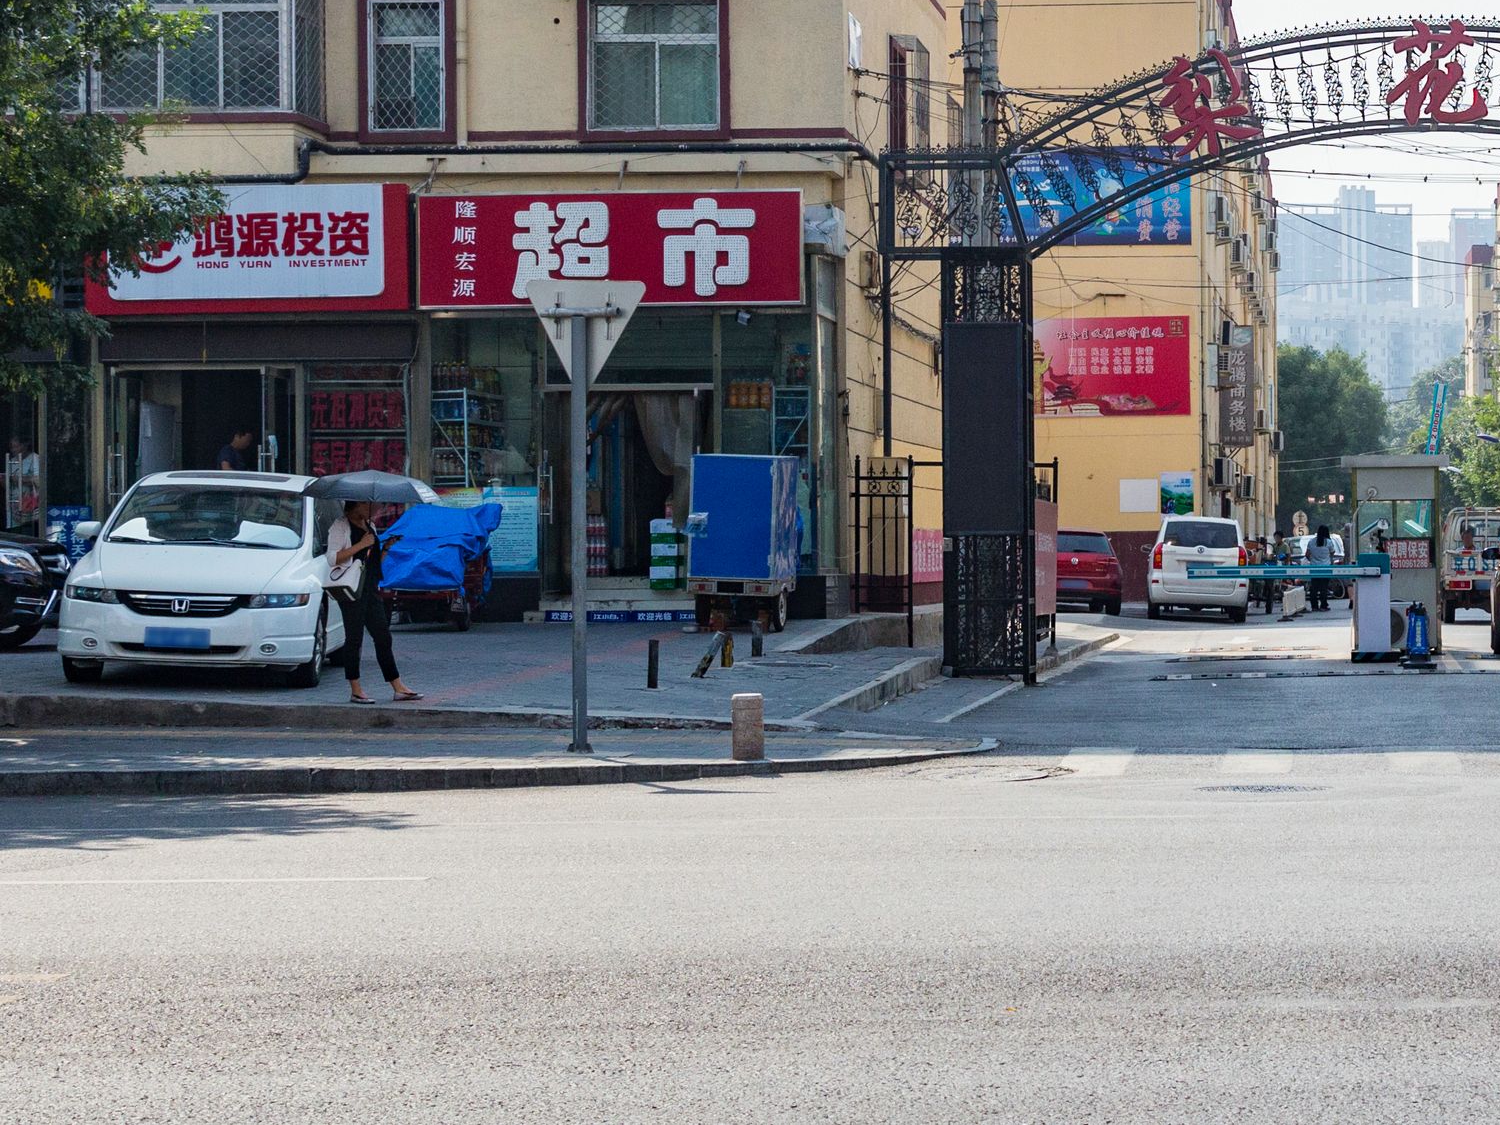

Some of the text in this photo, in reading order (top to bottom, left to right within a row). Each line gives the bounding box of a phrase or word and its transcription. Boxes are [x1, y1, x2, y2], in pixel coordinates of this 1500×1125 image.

[192, 211, 370, 257] 鸿源投资
[197, 258, 368, 269] HONG YUAN INVESTMENT
[452, 201, 477, 297] 隆顺宏源
[513, 198, 755, 299] 超市
[1228, 350, 1248, 432] 龙腾商务楼
[637, 611, 672, 621] 欢迎光临
